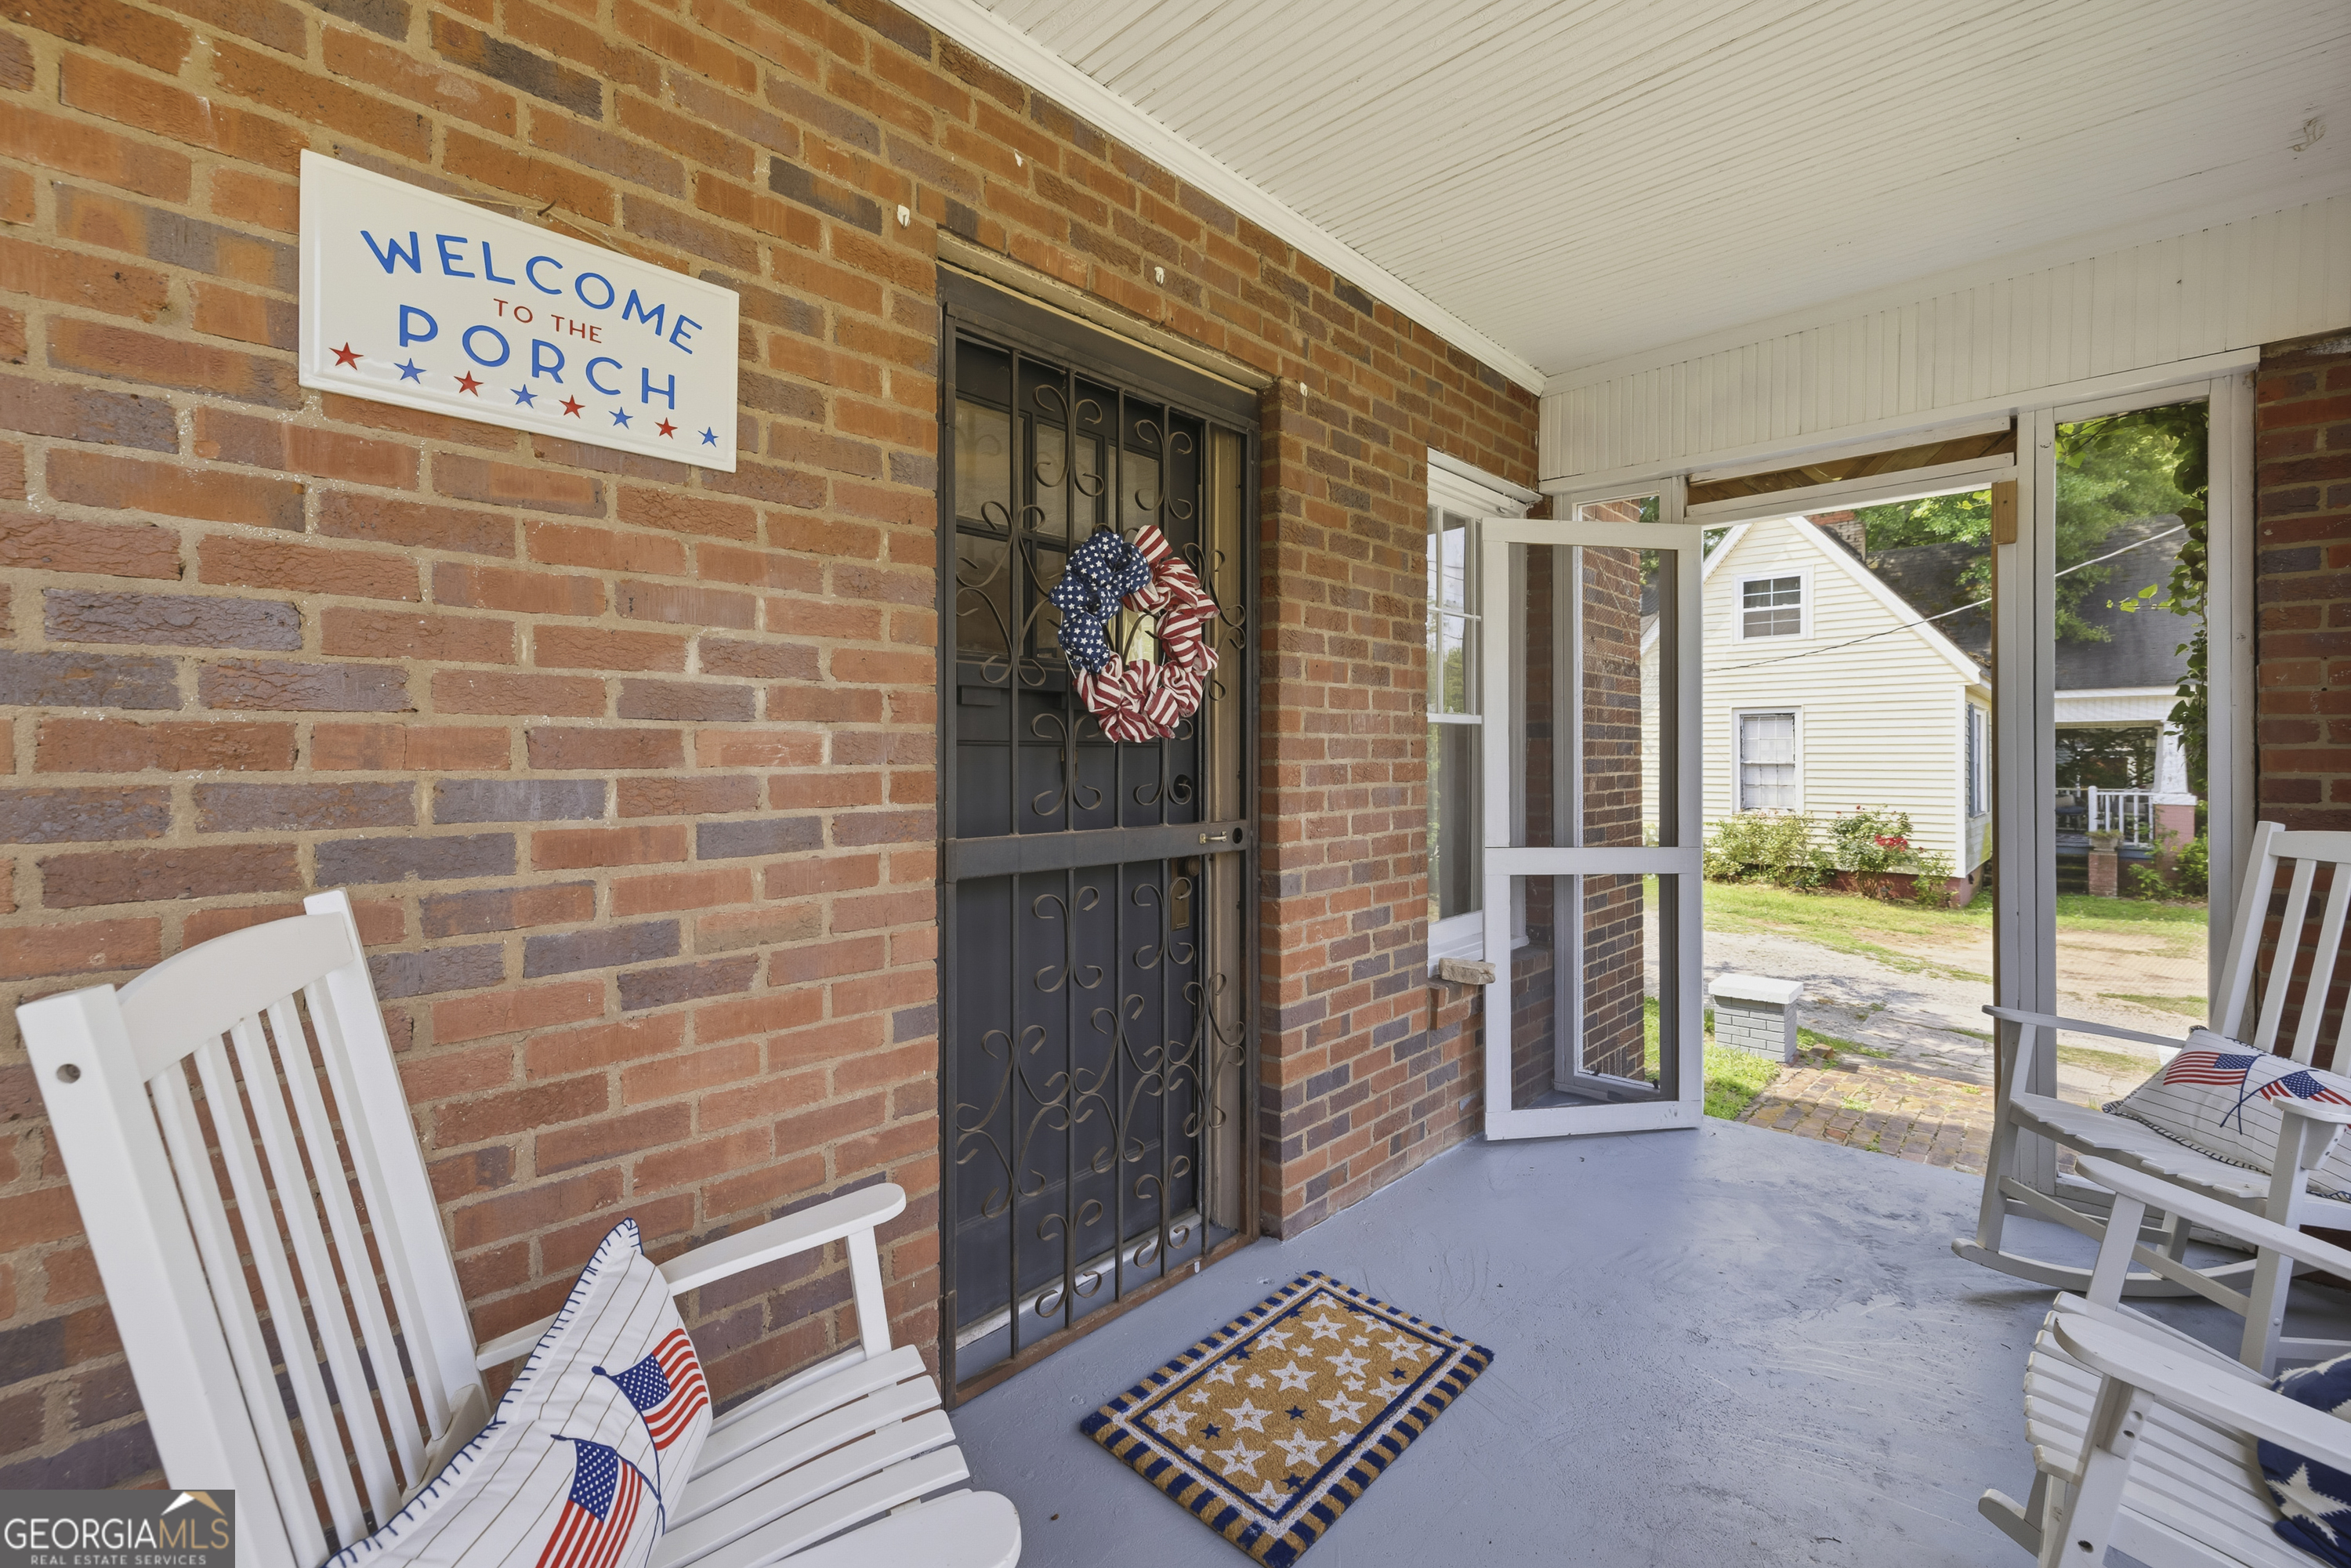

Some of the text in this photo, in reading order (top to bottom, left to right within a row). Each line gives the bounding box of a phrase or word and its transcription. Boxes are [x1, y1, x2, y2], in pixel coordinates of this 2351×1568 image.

[360, 230, 703, 355] WELCOME
[494, 298, 603, 344] TO THE
[399, 304, 676, 411] PORCH
